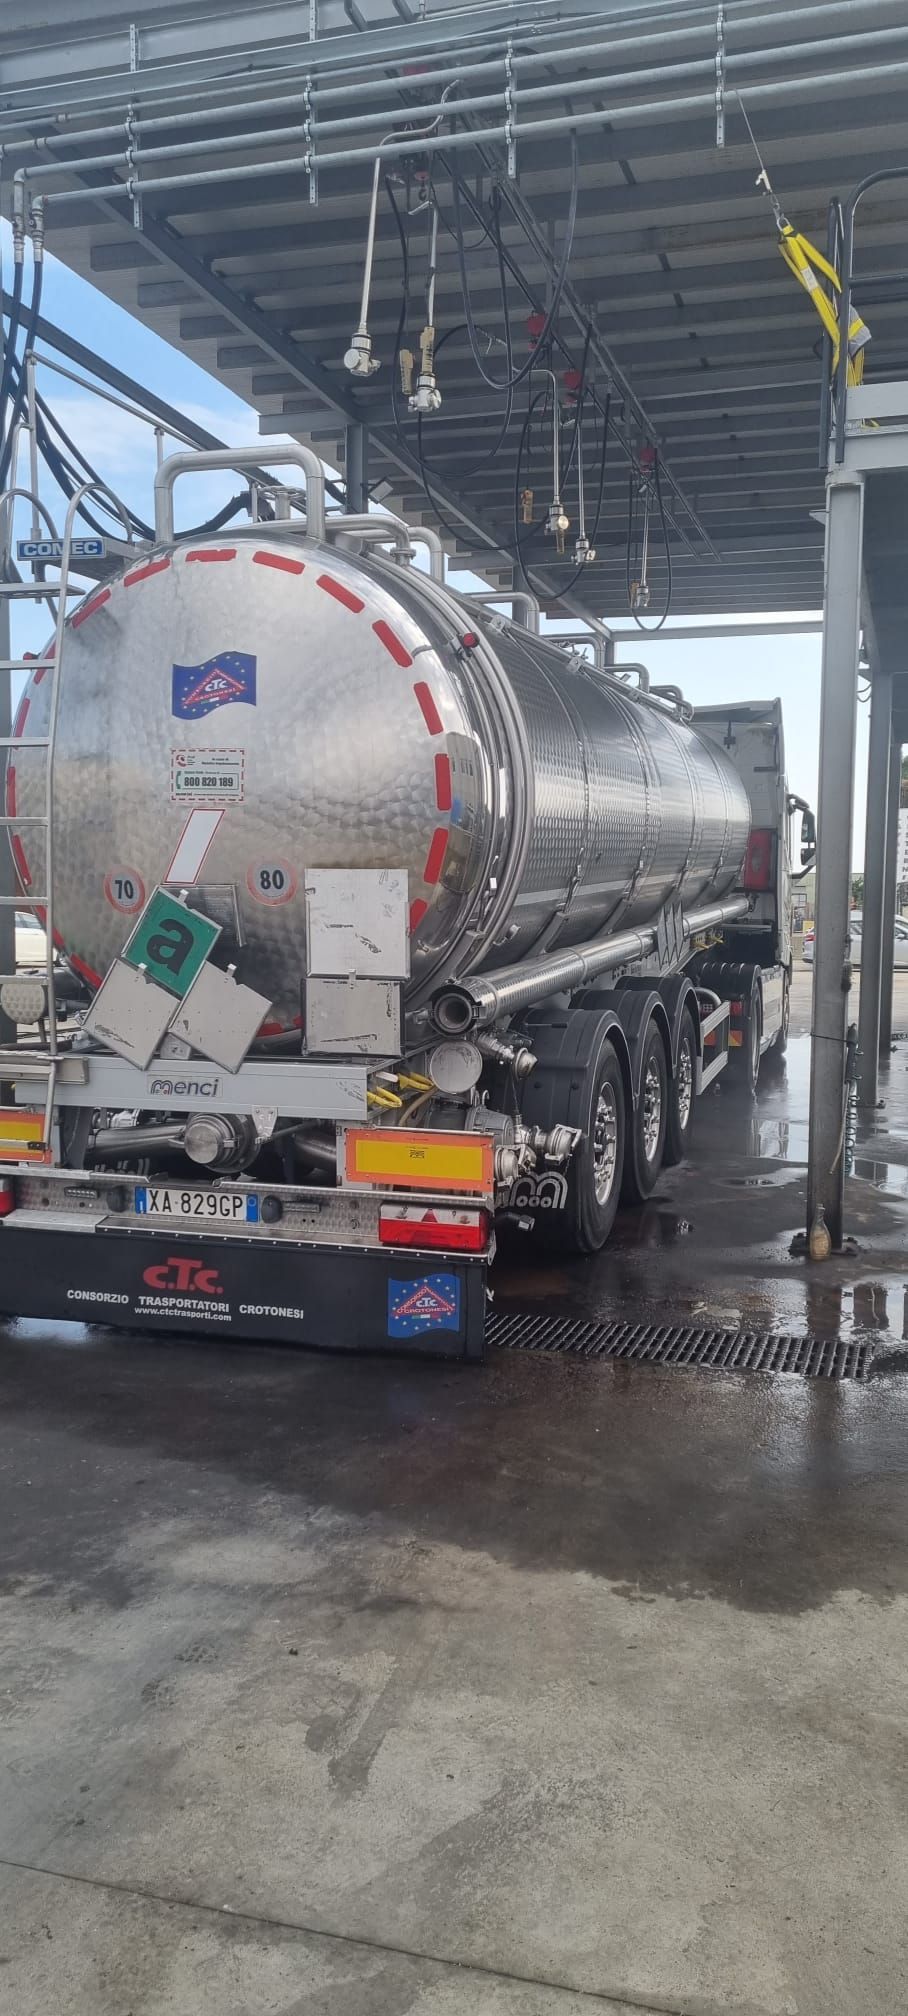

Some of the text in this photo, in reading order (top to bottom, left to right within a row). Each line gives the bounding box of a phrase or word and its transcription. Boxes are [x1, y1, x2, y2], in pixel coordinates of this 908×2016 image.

[184, 776, 234, 787] 800 820 189
[115, 880, 134, 899] 70
[260, 870, 285, 890] 80
[146, 918, 194, 976] a
[66, 1289, 304, 1320] CONSORZIO TRASPORTATORI CROTONESI
[134, 1306, 232, 1322] www.ctctrasporti.com
